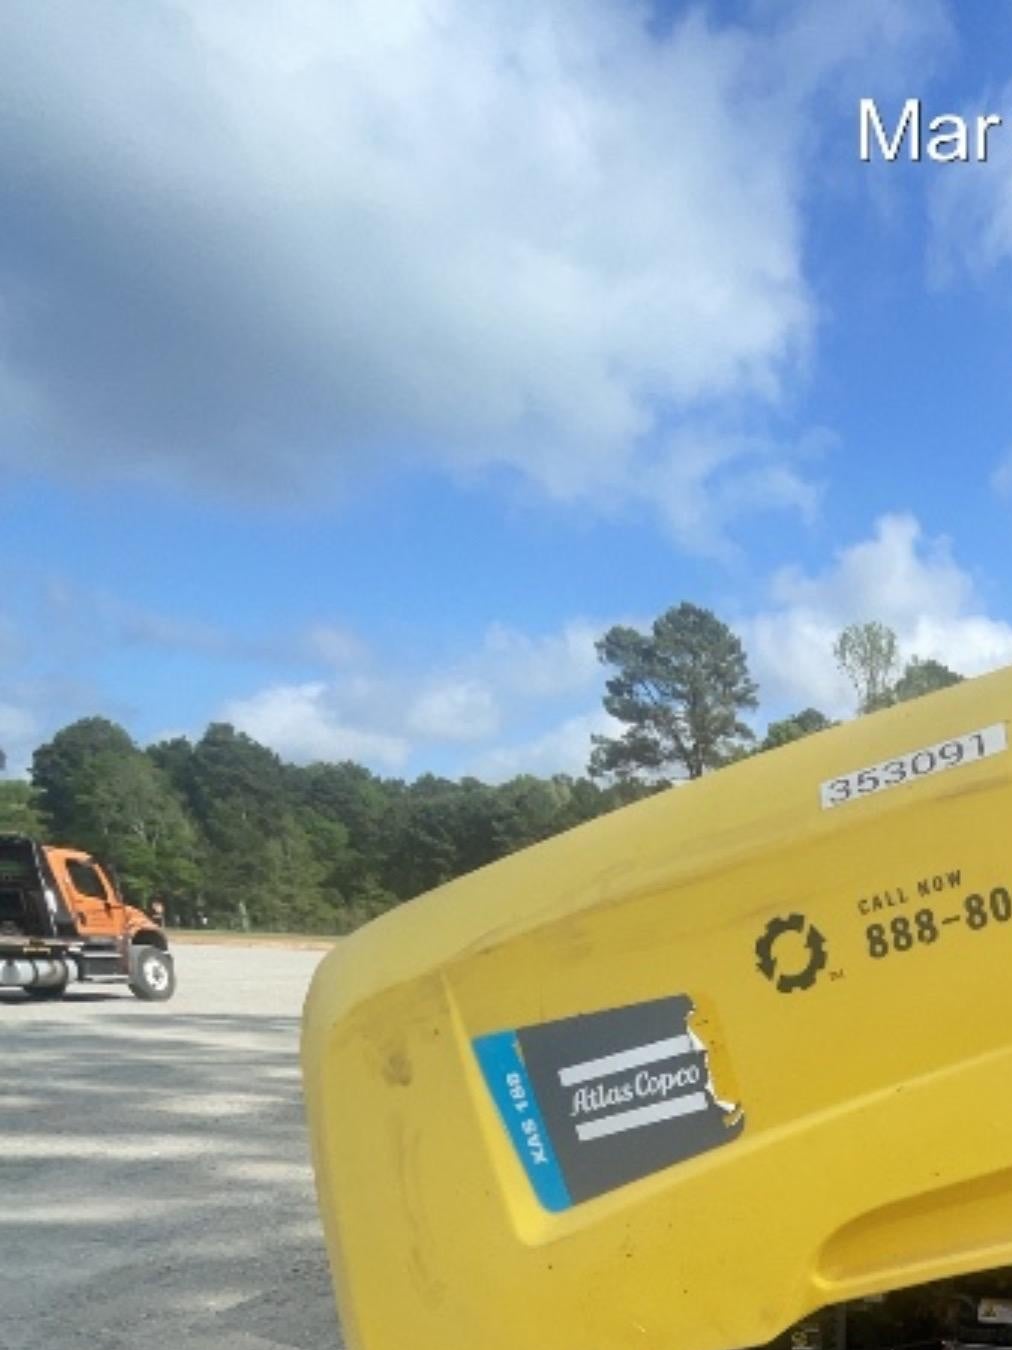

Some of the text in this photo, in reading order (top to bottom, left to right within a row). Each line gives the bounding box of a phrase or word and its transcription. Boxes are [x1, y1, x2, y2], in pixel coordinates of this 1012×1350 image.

[829, 734, 985, 803] 353091
[857, 869, 962, 916] CALL NOW
[569, 1064, 700, 1116] Atlas Copco
